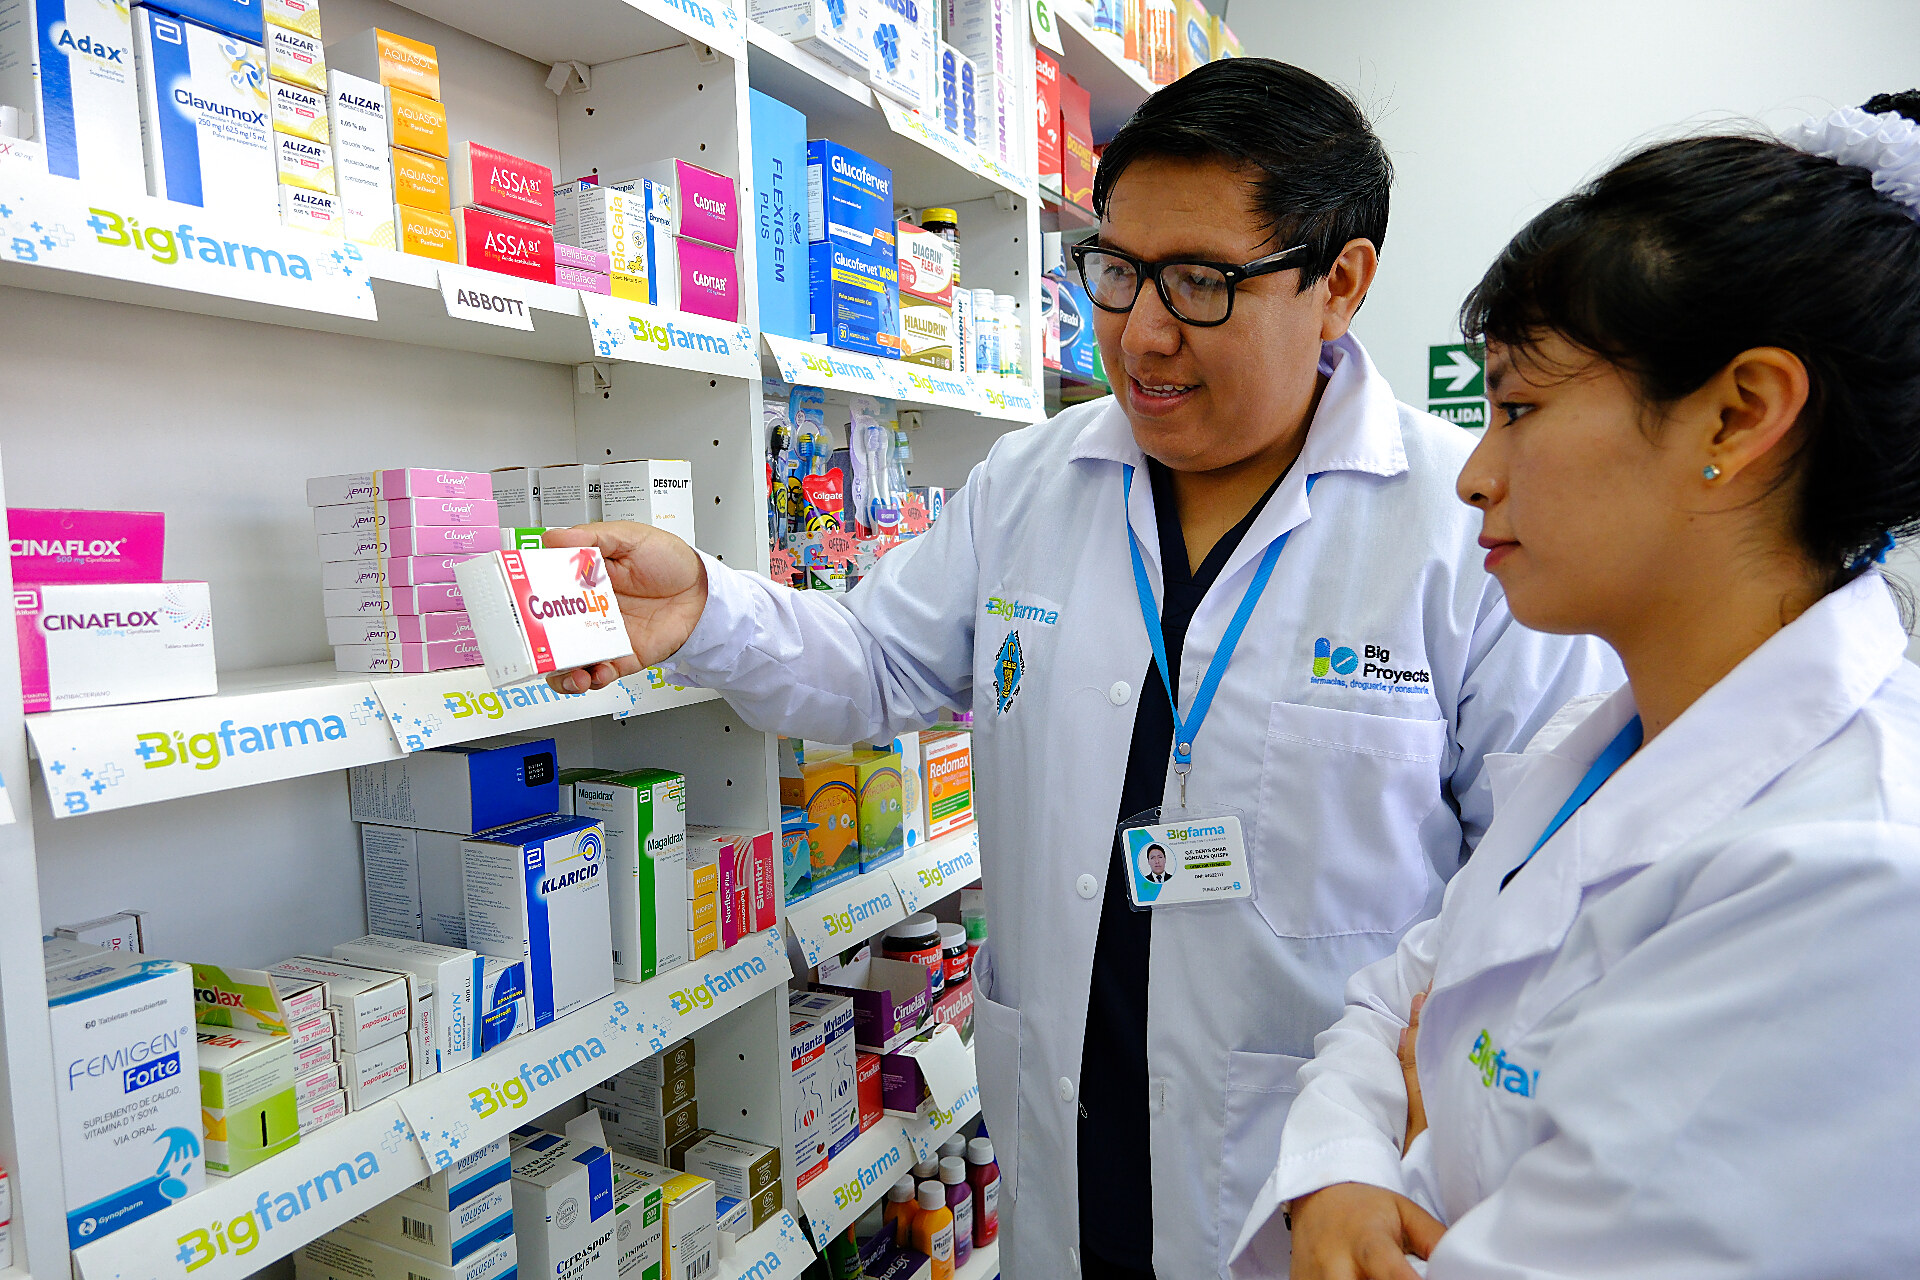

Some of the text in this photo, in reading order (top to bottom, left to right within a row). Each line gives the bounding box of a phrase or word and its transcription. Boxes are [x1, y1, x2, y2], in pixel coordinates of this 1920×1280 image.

[1036, 1, 1050, 33] 6
[58, 29, 123, 64] Adax
[275, 32, 314, 52] ALIZAR
[384, 48, 433, 70] AQUASOL
[278, 88, 316, 107] ALIZAR
[339, 92, 381, 113] ALIZAR
[397, 106, 443, 128] AQUASOL
[410, 123, 434, 135] Panthenol
[283, 140, 321, 157] ALIZAR
[400, 167, 445, 187] AQUASOL
[832, 155, 888, 195] Glucofervet
[412, 183, 436, 194] Panthenol
[293, 193, 332, 209] ALIZAR
[693, 193, 726, 216] CADITAR
[760, 192, 769, 239] PLUS
[773, 158, 785, 283] FLEXIGEM
[407, 223, 451, 241] AQUASOL
[610, 196, 625, 272] BioGaia
[88, 207, 312, 281] Bigfarma
[420, 238, 444, 249] Panthenol
[912, 241, 942, 264] DIAGRIN
[561, 247, 596, 264] Bellaface
[921, 258, 934, 273] FLEX
[561, 270, 597, 286] Bellaface
[834, 252, 878, 277] Glucofervet
[879, 265, 898, 284] MSM
[693, 271, 727, 292] CADITAR
[458, 288, 523, 316] ABBOTT
[904, 314, 946, 338] HIALUDRIN
[1059, 309, 1079, 328] Panadol
[629, 315, 730, 356] Bigfarma
[840, 329, 847, 339] 30
[653, 479, 689, 489] DESTOLIT
[813, 491, 843, 502] Colgate
[9, 540, 121, 557] CINAFLOX
[74, 557, 85, 565] mg
[770, 558, 789, 578] FERTA
[529, 590, 610, 619] ControLip
[986, 597, 1059, 625] Bigfarma
[43, 611, 158, 632] CINAFLOX
[113, 630, 125, 638] mg
[1365, 645, 1390, 663] Big
[1363, 663, 1429, 684] Proyects
[56, 690, 111, 701] ANTIBACTERIANO
[135, 715, 347, 771] Bigfarma
[930, 754, 969, 779] Redomax
[578, 788, 613, 801] Magaldrax
[647, 833, 684, 852] Magaldrax
[1167, 825, 1225, 841] Bigfarma
[542, 863, 599, 895] KLARICID
[670, 953, 768, 1017] Bigfarma
[195, 986, 245, 1009] rolax
[935, 990, 972, 1025] Ciruelax
[85, 999, 168, 1030] 60 Tabletas recubiertas
[893, 996, 926, 1022] Ciruelax
[453, 994, 461, 1053] EGOGYN
[824, 1008, 852, 1034] Mylanta
[834, 1027, 845, 1039] Dos
[791, 1033, 823, 1060] Mylanta
[69, 1030, 178, 1091] FEMIGEN
[801, 1054, 813, 1066] Dos
[126, 1056, 179, 1092] Forte
[468, 1036, 607, 1120] Bigfarma
[859, 1061, 880, 1083] Ciruelax
[83, 1086, 182, 1130] SUPLEMENTO DE CALCIO,
[84, 1105, 159, 1141] VITAMINA D Y SOYA
[113, 1125, 157, 1147] VIA ORAL
[457, 1150, 487, 1171] VOLUSOL
[834, 1144, 901, 1211] Bigfarma
[99, 1200, 144, 1225] Gynopharm
[176, 1151, 380, 1273] Bigfarma
[460, 1203, 489, 1225] VOLUSOL
